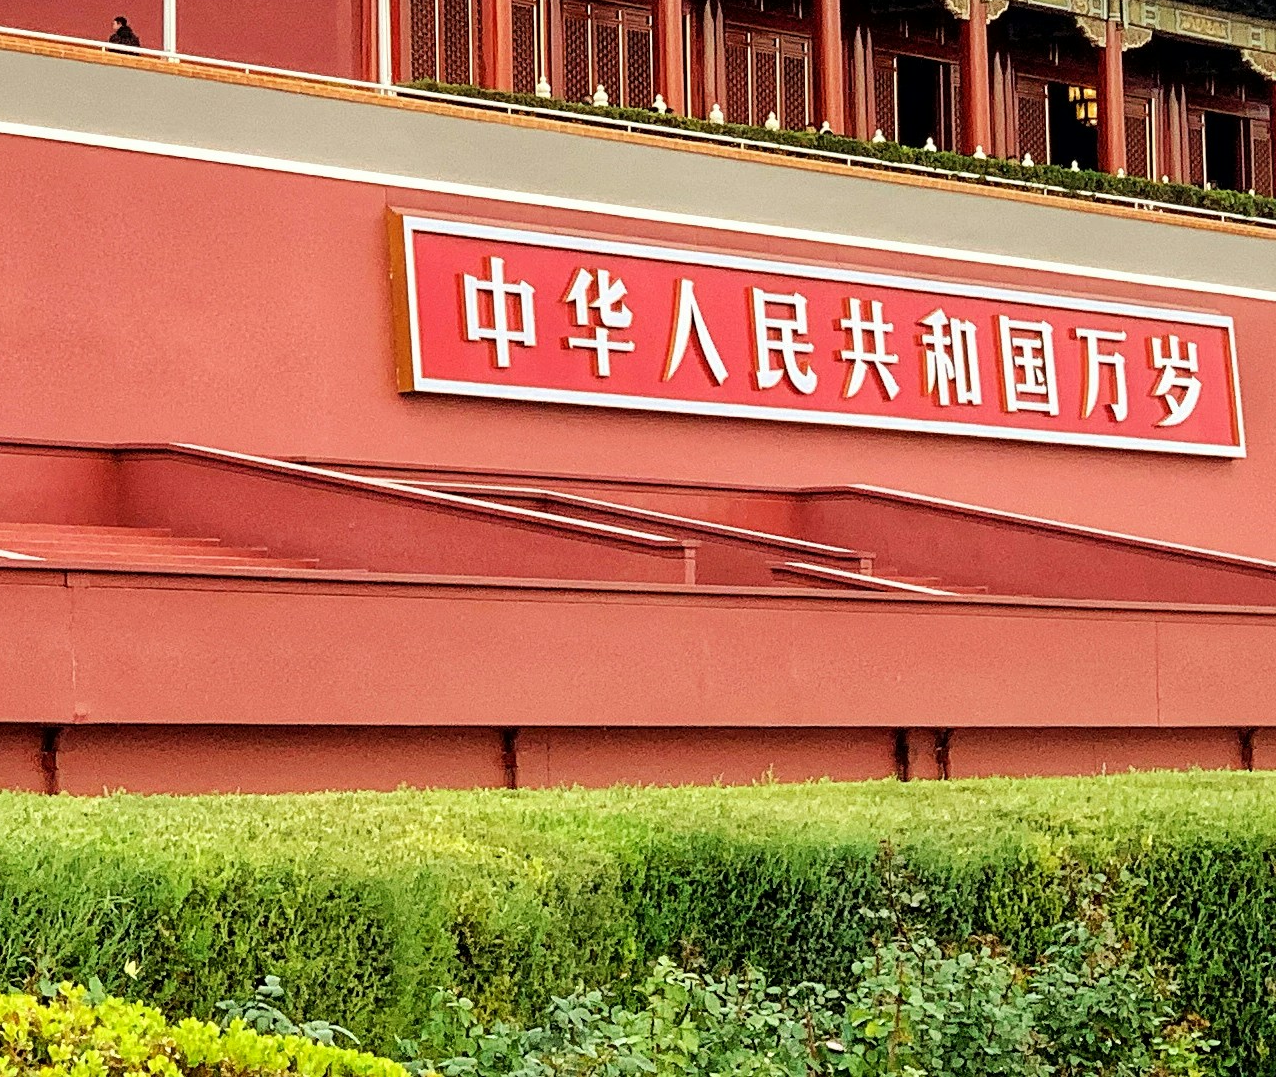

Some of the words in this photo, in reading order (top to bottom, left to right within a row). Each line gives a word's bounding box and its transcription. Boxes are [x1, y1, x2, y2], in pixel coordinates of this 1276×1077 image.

[462, 256, 1202, 427] 中华人民共和国万岁
